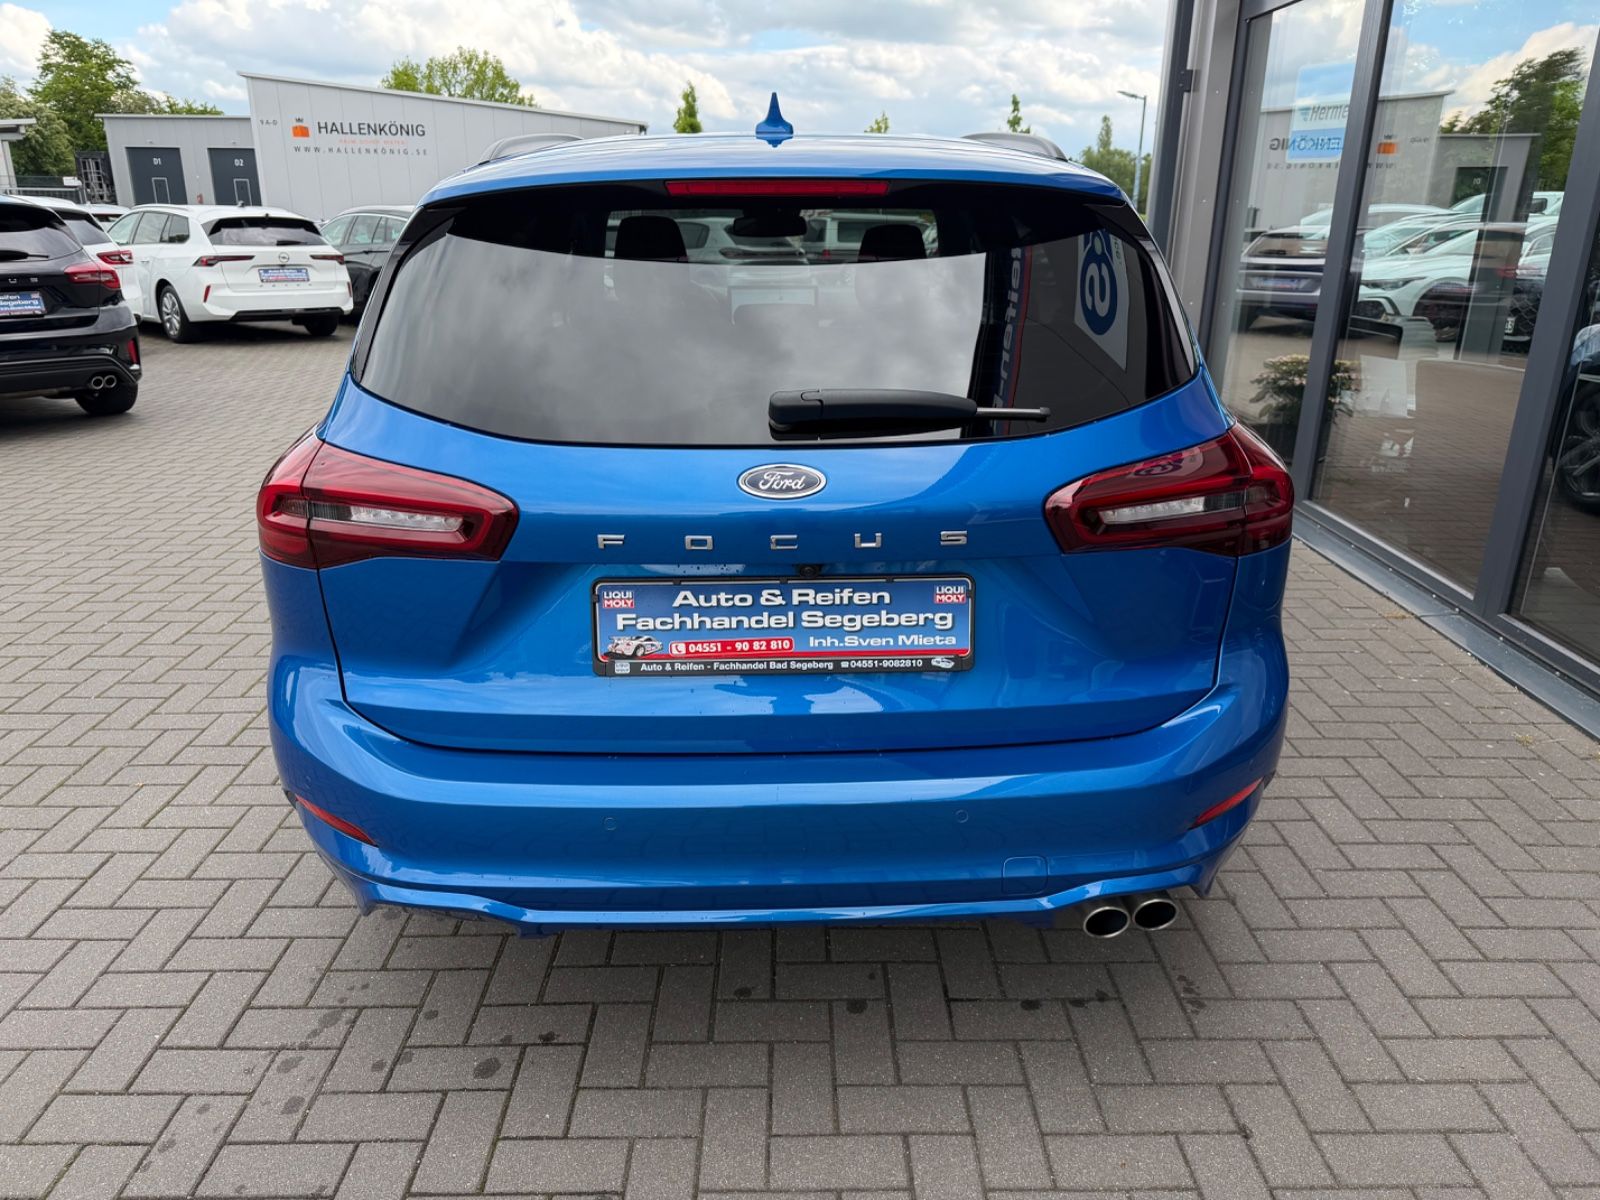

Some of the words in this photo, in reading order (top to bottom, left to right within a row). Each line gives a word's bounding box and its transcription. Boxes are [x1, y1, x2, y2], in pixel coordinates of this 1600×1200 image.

[317, 121, 426, 137] HALLENKÖNIG
[758, 470, 806, 492] Ford
[597, 530, 968, 551] FOCUS
[603, 590, 633, 600] LIQUI
[936, 586, 965, 594] LIQUI
[603, 600, 634, 608] MOLY
[672, 590, 752, 607] Auto
[760, 589, 786, 606] &
[791, 588, 892, 606] Reifen
[936, 594, 966, 603] MOLY
[616, 611, 795, 631] Fachhandel
[801, 610, 954, 632] Segeberg
[688, 642, 722, 653] 04551
[735, 641, 750, 652] 90
[752, 640, 767, 651] 82
[770, 639, 790, 651] 810
[809, 635, 894, 648] Inh.Sven
[898, 634, 957, 646] Mieta
[640, 662, 663, 672] Auto
[665, 663, 672, 671] &
[674, 662, 705, 672] Reifen
[713, 661, 767, 672] Fachhandel
[769, 661, 788, 670] Bad
[790, 660, 834, 671] Segeberg
[850, 659, 923, 669] 04551-9082810
